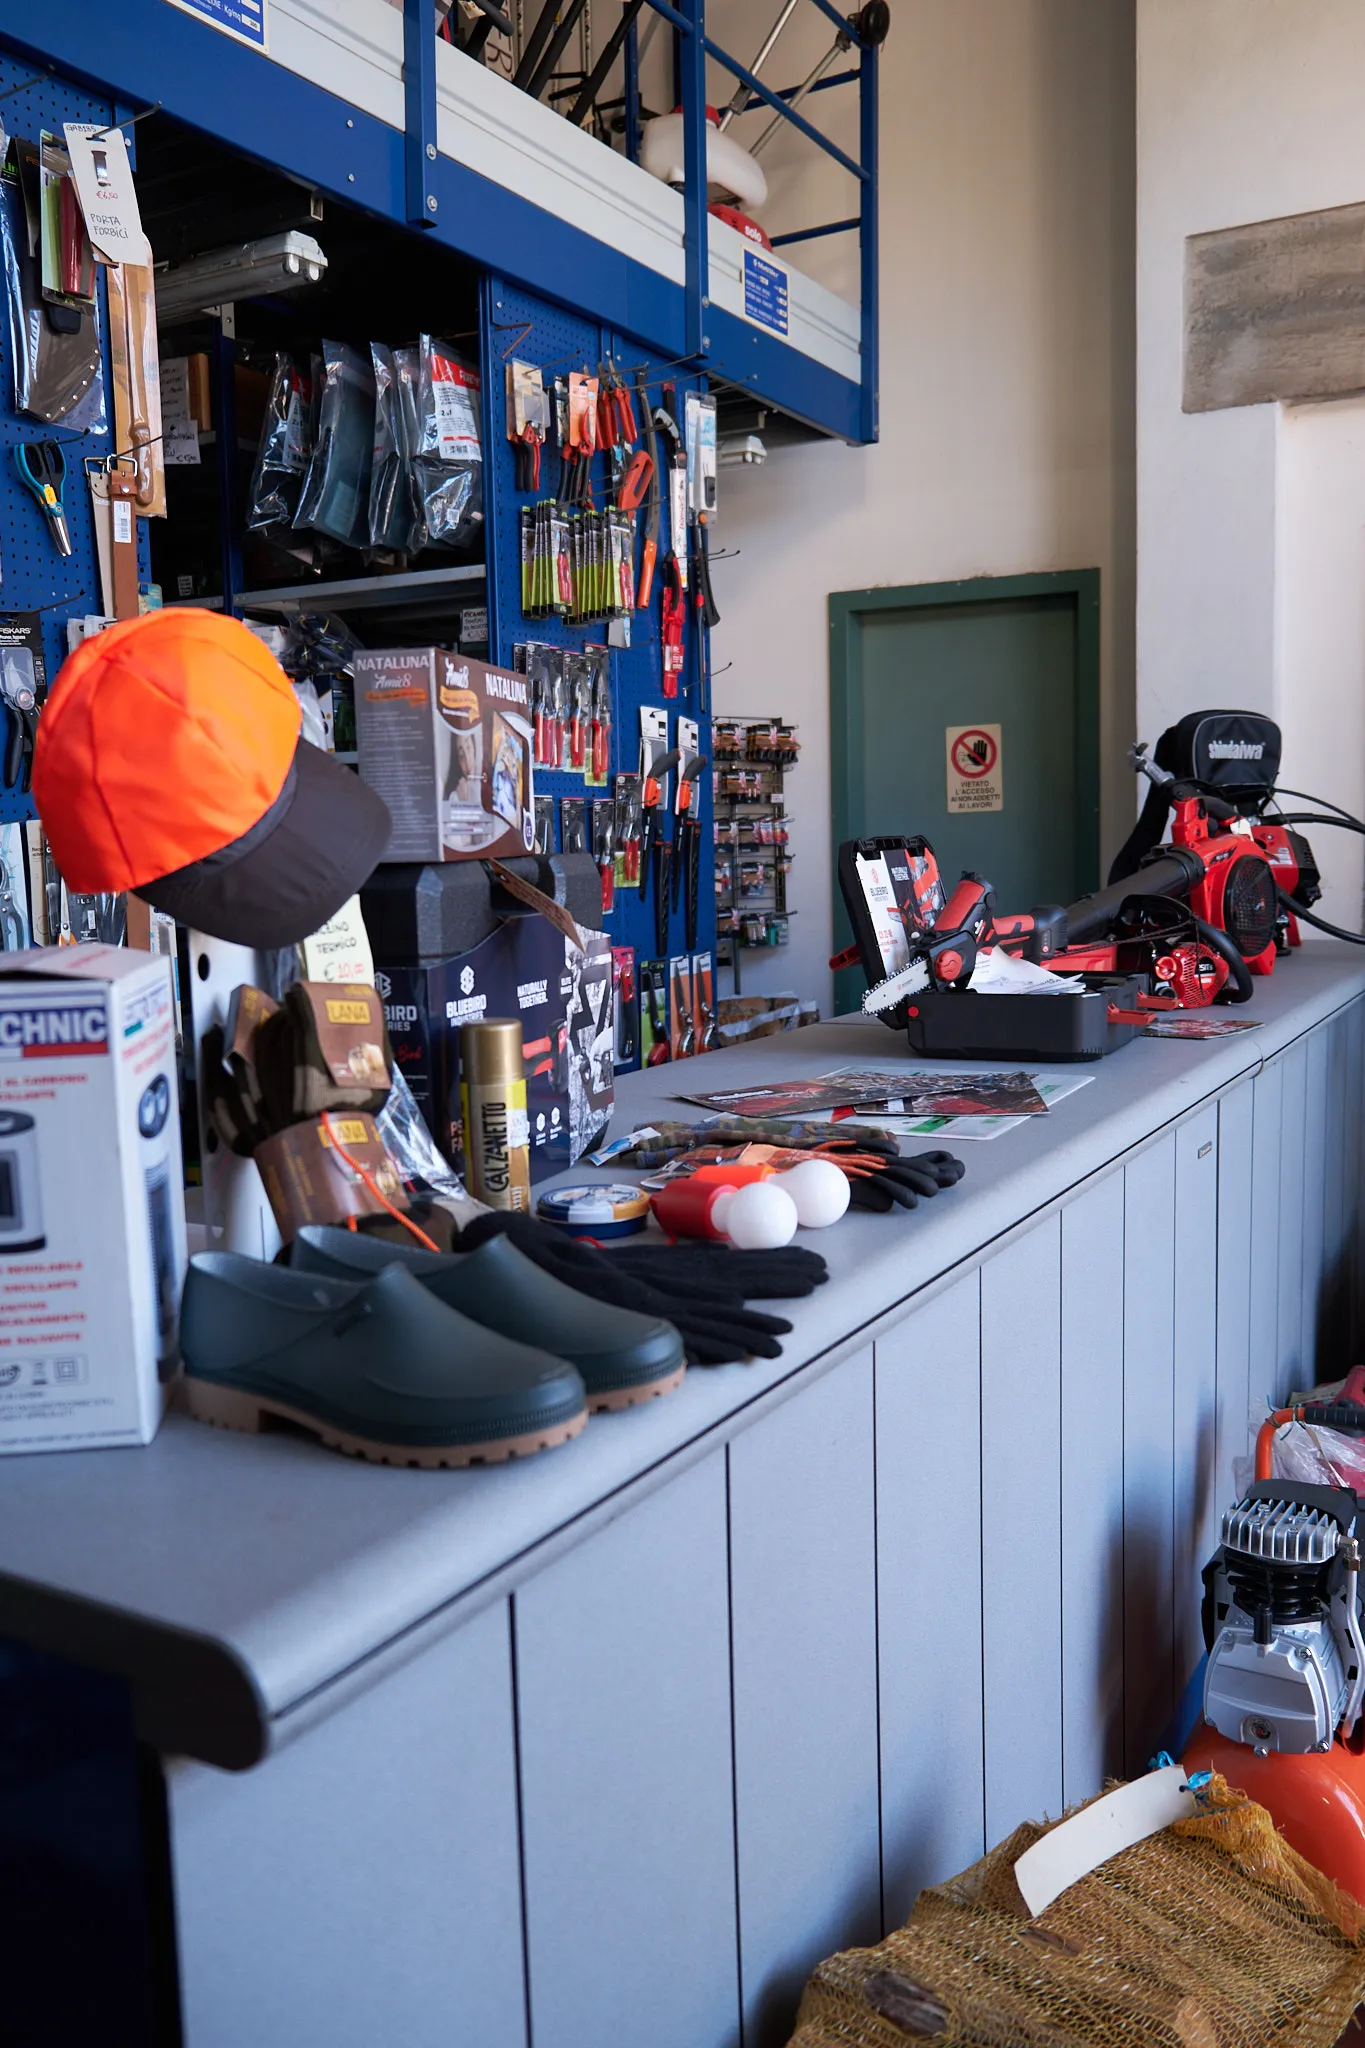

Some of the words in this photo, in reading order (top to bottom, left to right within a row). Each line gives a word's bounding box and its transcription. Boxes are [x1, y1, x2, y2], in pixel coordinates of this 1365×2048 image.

[90, 213, 121, 226] PORTA
[745, 225, 762, 242] solo
[357, 655, 430, 671] NATALUNA
[485, 672, 528, 705] NATALUNA
[1208, 740, 1264, 760] shindaiwa
[955, 787, 995, 796] L'ACCESSO
[960, 780, 990, 788] VIETATO
[972, 794, 1001, 802] ADDETTI
[316, 937, 357, 954] TERMICO
[517, 979, 548, 998] NATURALLY
[446, 994, 487, 1019] BLUEBIRD
[519, 991, 549, 1010] TOGETHER.
[329, 1003, 368, 1021] LANA
[384, 1005, 417, 1022] BIRD
[482, 1102, 510, 1193] CALZANETTO
